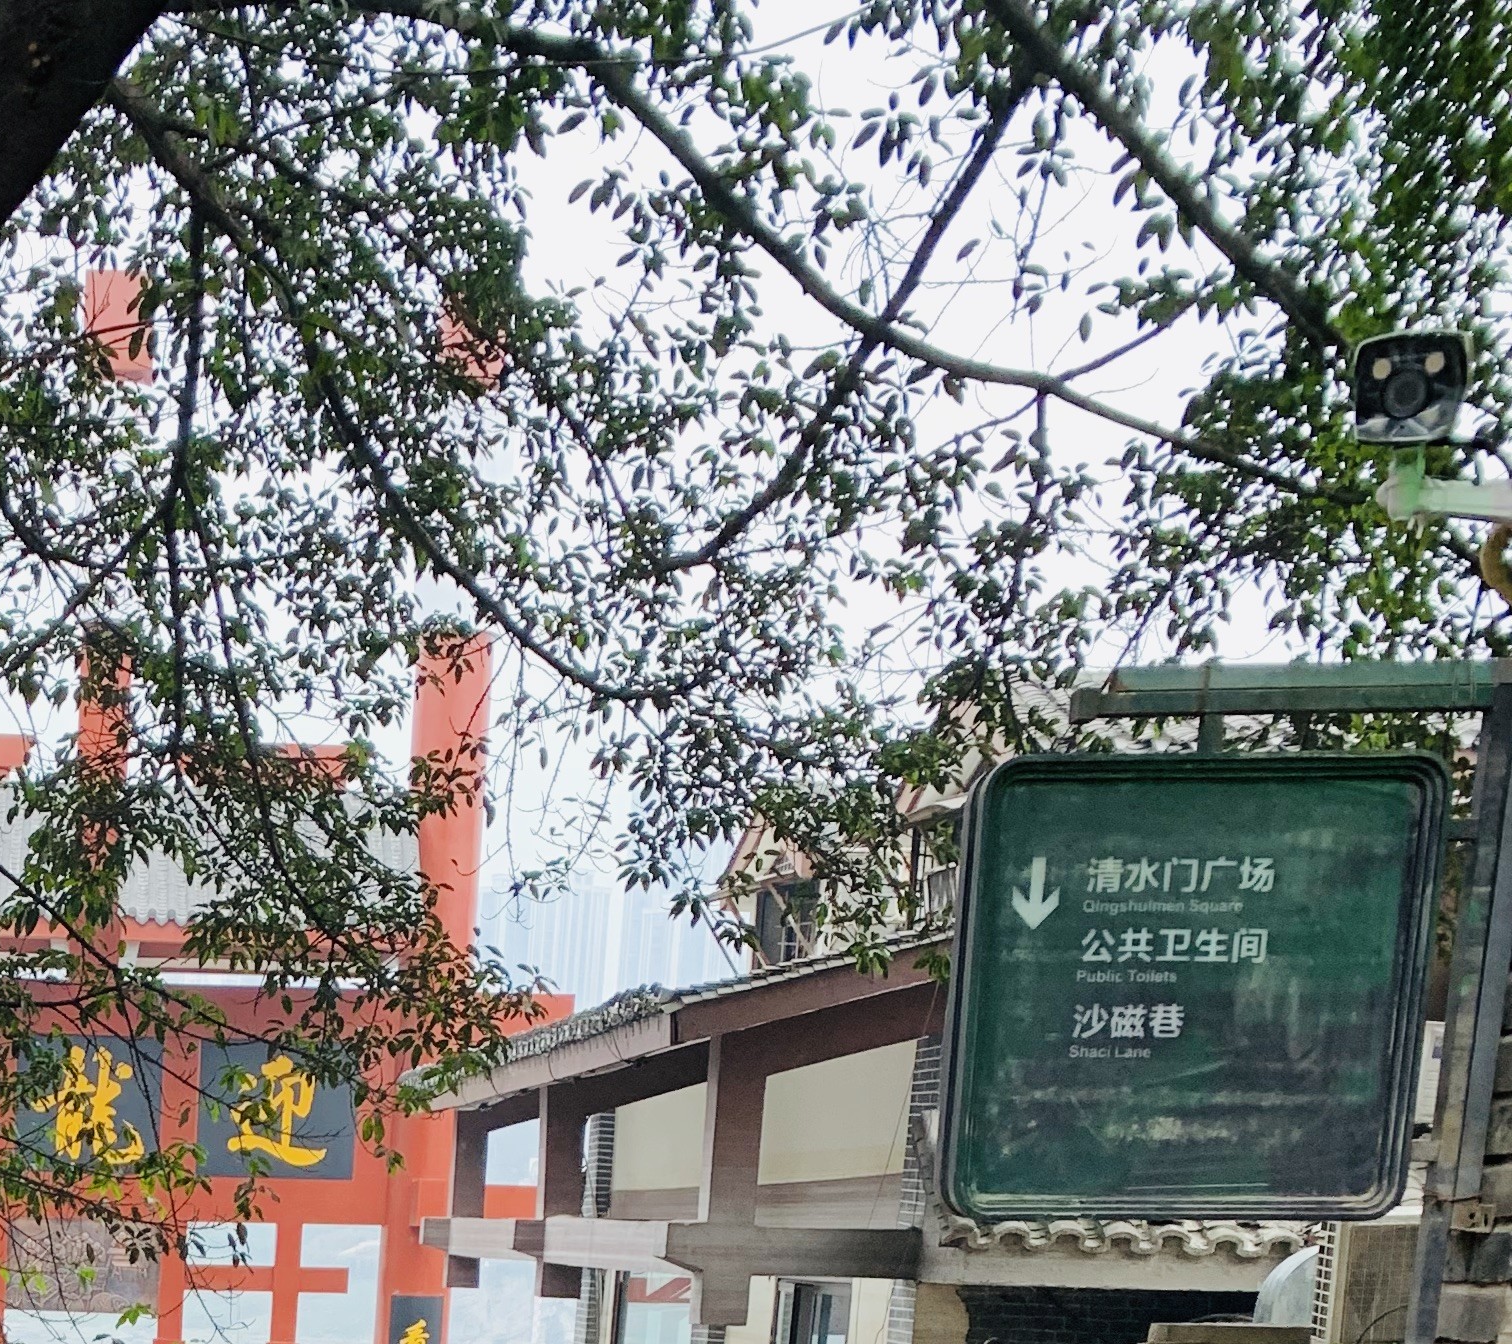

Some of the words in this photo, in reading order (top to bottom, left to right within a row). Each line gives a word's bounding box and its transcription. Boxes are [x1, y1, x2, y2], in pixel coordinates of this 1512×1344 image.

[1086, 855, 1276, 893] 清水门广场
[1082, 898, 1185, 914] Qingshuimen
[1189, 898, 1244, 914] Square
[1080, 928, 1268, 963] 公共卫生间
[1076, 969, 1122, 983] Public
[1127, 969, 1177, 983] Toilets
[1071, 1003, 1185, 1039] 沙磁巷
[1069, 1044, 1110, 1058] Shaci
[1114, 1044, 1151, 1058] Lane
